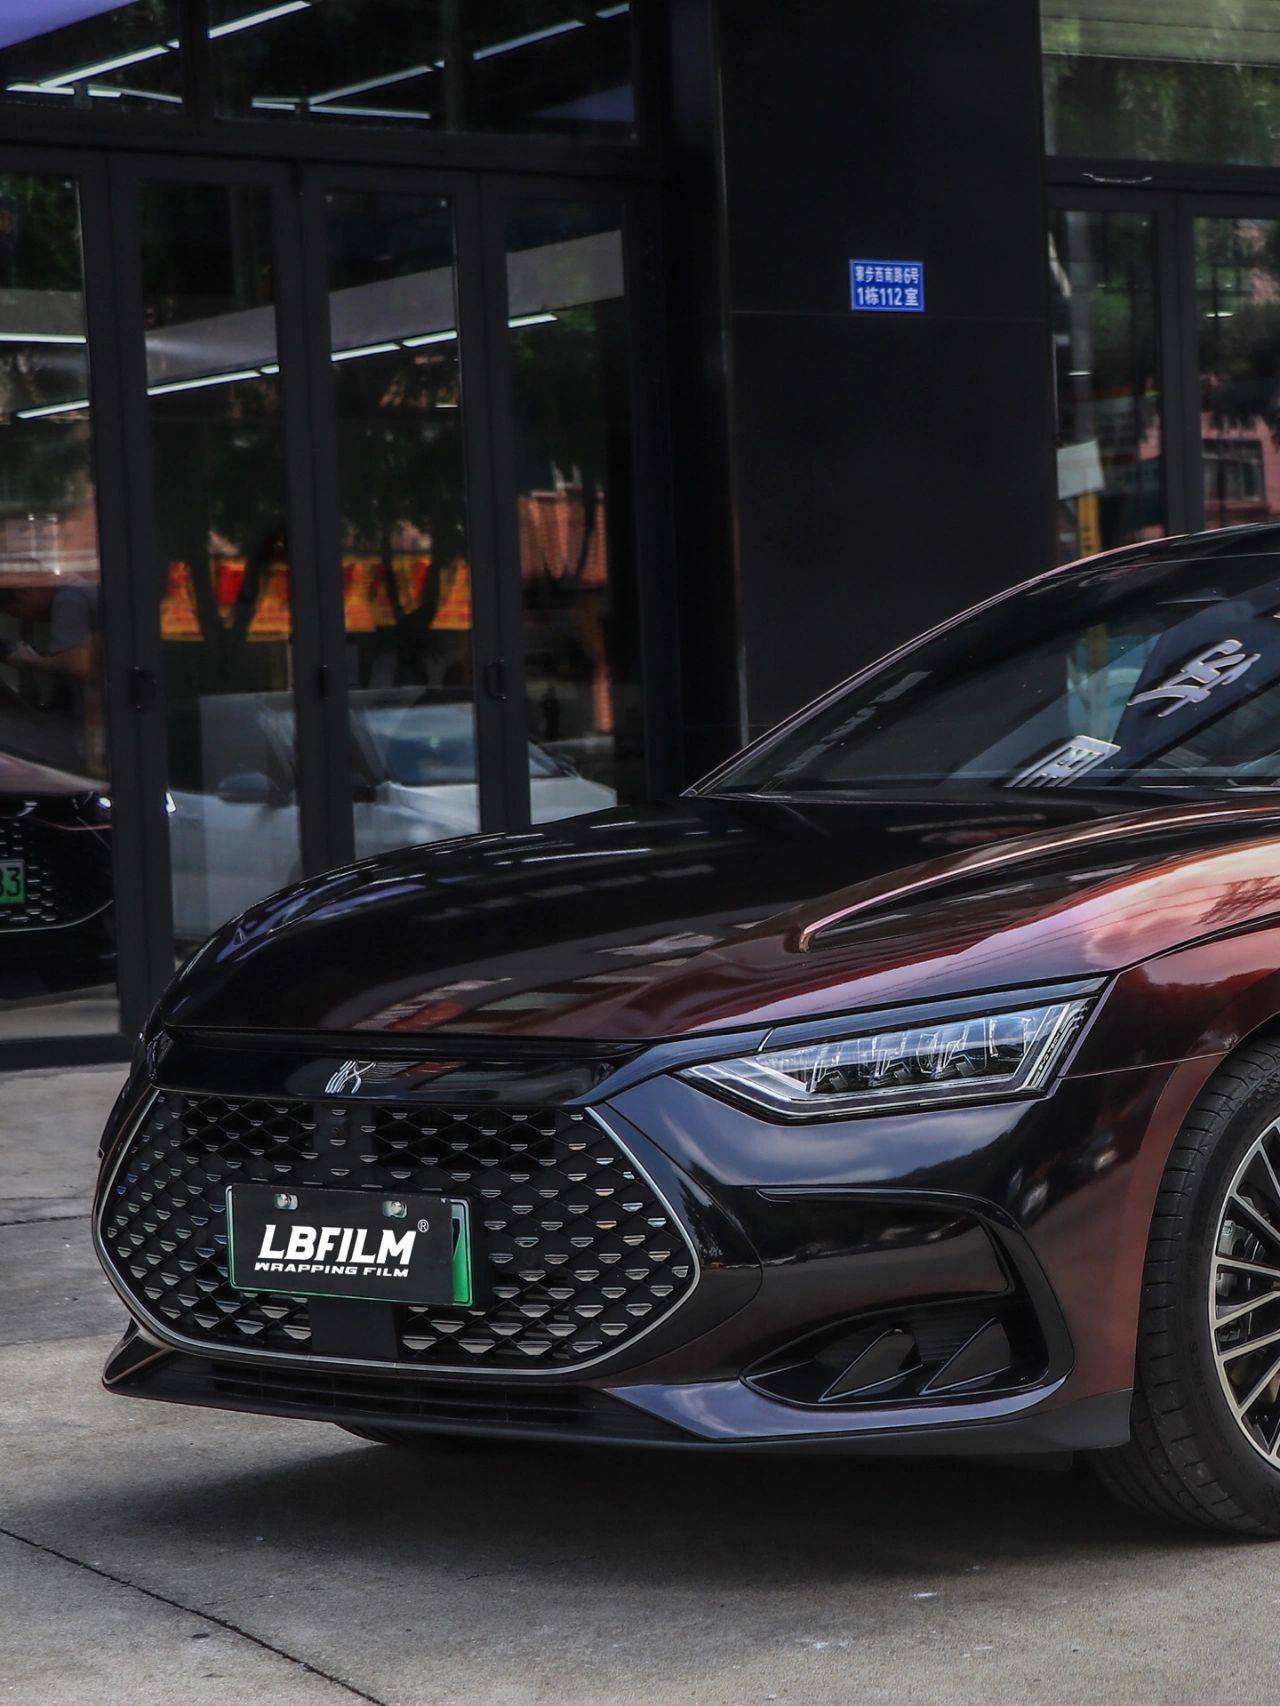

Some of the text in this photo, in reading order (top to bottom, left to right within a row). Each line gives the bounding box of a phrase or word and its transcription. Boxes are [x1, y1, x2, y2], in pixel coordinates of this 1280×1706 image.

[258, 1224, 417, 1265] LBFILM
[254, 1262, 409, 1278] WRAPPING FILM
